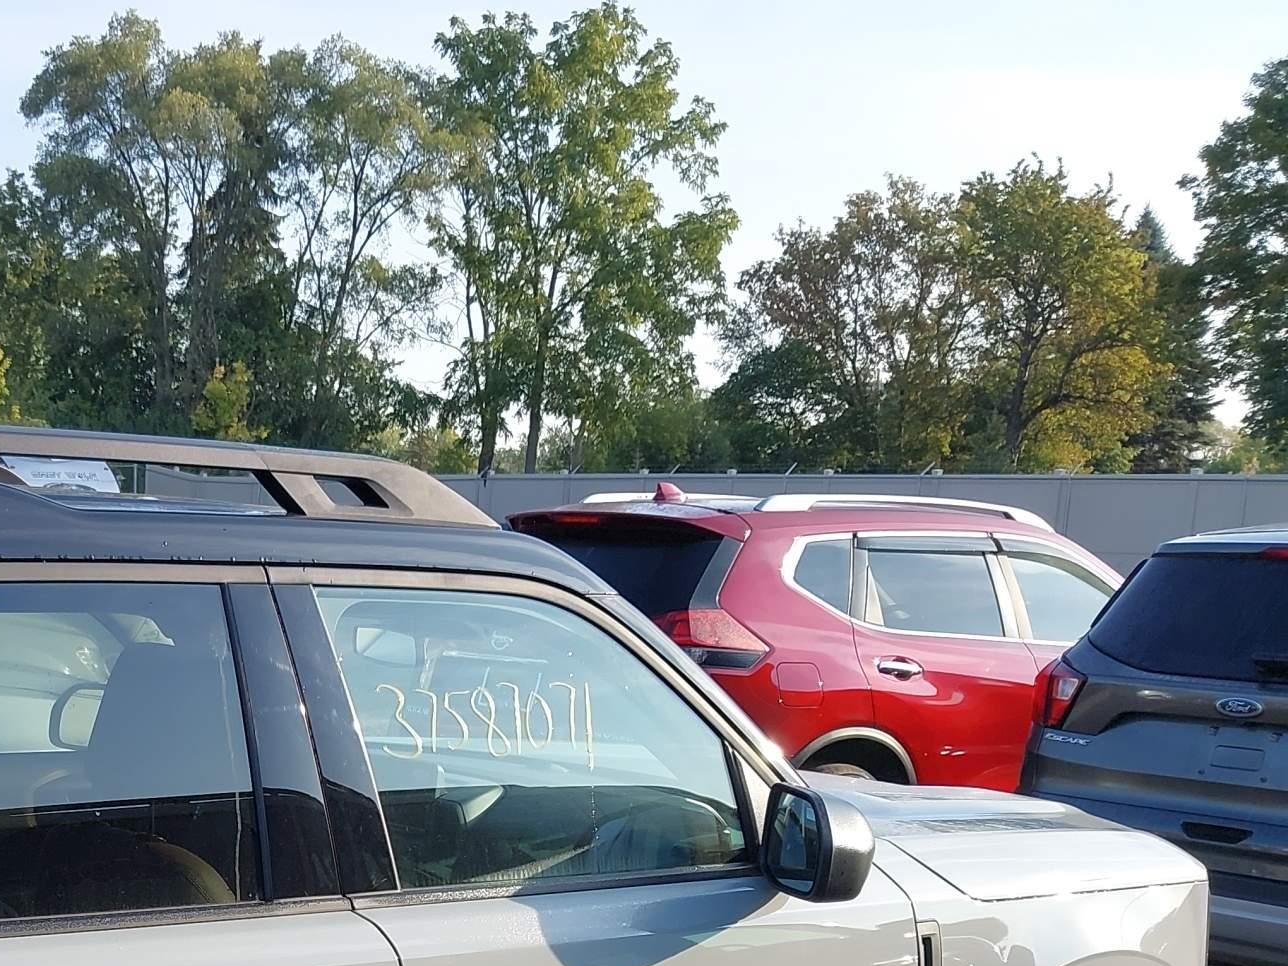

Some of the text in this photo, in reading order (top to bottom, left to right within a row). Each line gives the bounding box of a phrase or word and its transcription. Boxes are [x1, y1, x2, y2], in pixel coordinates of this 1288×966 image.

[1223, 701, 1251, 713] Ford
[375, 682, 594, 772] 37587071
[1044, 732, 1090, 746] ESCAPE
